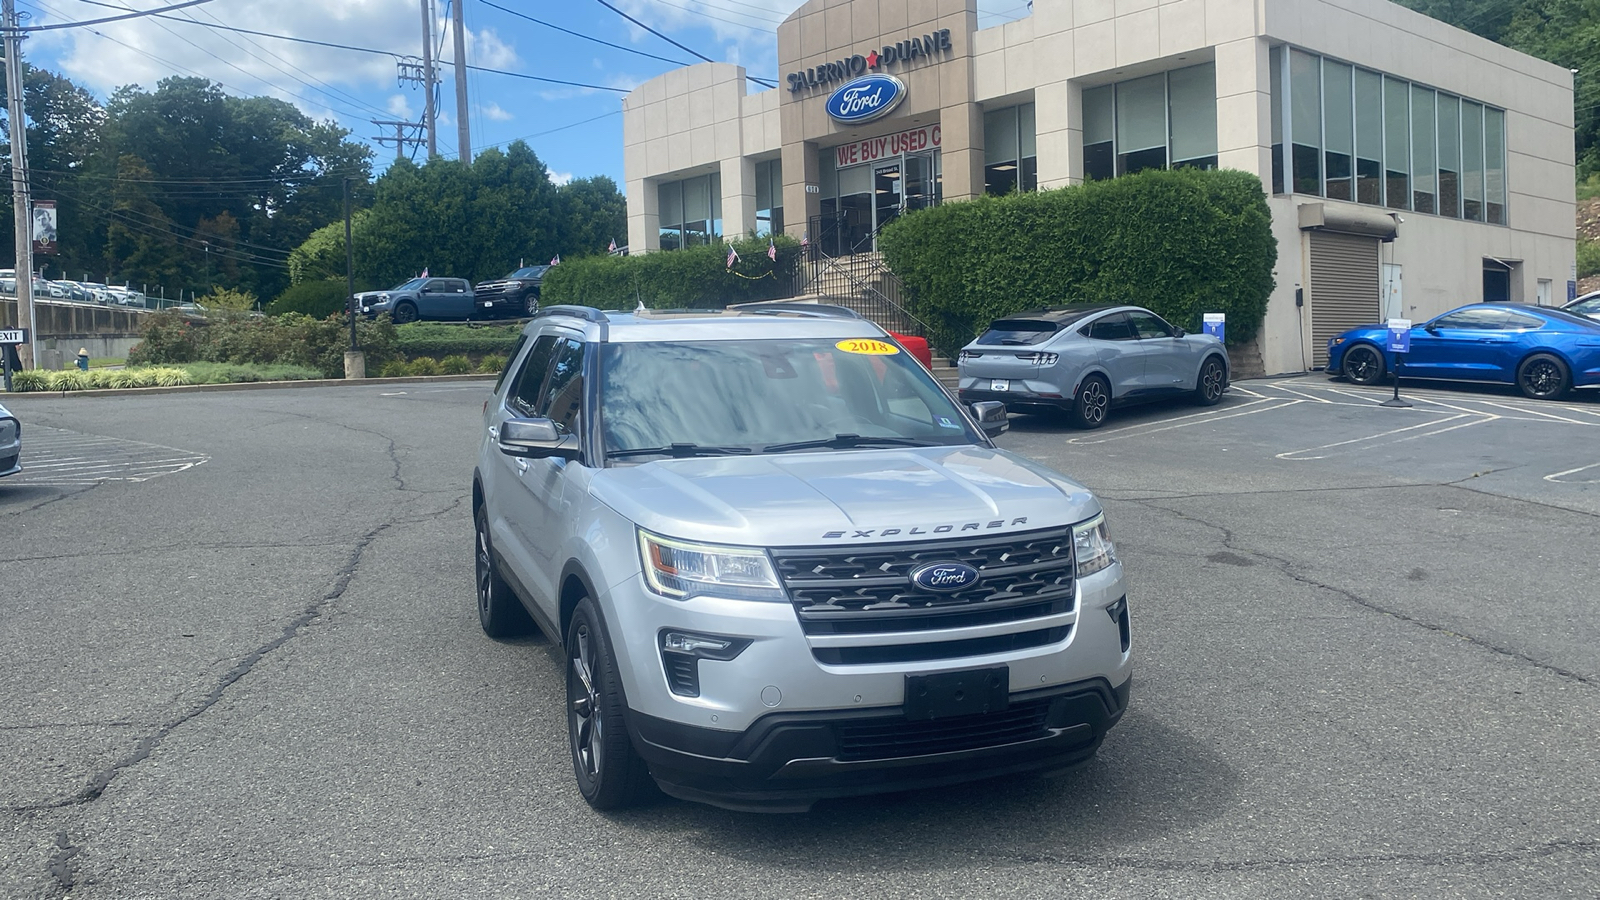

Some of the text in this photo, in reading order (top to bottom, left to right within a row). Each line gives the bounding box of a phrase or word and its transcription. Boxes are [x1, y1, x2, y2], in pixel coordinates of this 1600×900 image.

[787, 28, 952, 93] SALERNO DUANE
[840, 84, 882, 115] Ford
[838, 144, 857, 165] WE
[861, 138, 887, 161] BUY
[891, 129, 927, 154] USED
[849, 342, 888, 352] 2018
[822, 516, 1027, 539] EXPLORER
[931, 568, 966, 585] Ford
